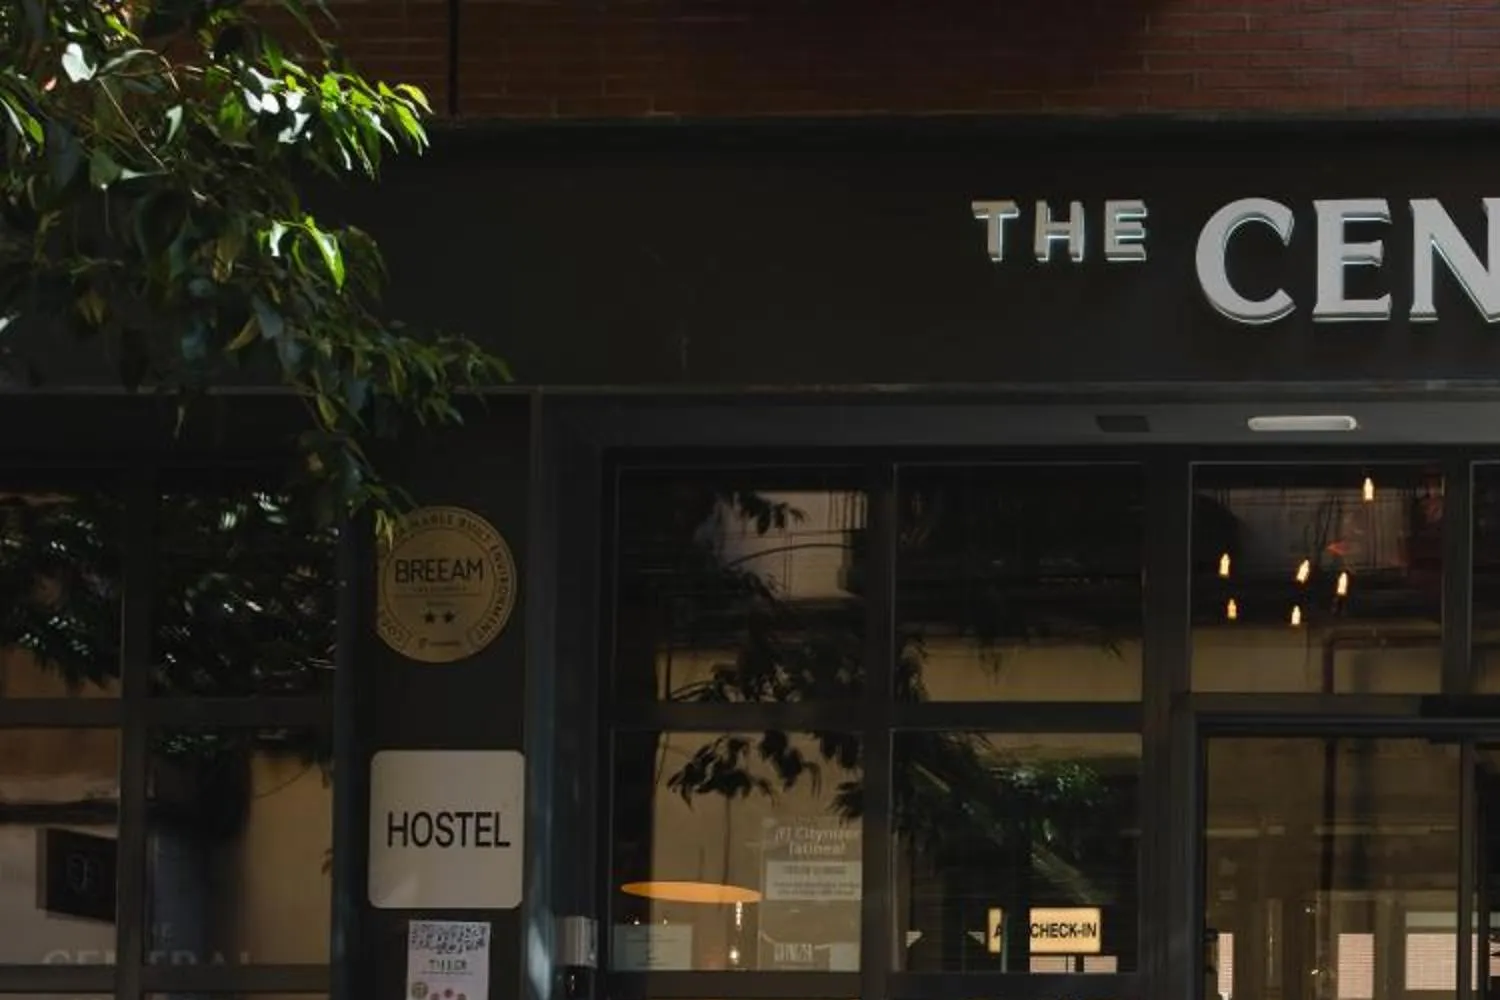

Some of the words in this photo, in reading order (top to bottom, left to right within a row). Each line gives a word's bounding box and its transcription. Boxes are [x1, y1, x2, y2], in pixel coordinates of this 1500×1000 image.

[974, 200, 1148, 262] THE
[394, 557, 484, 584] BREEAM
[387, 811, 511, 848] HOSTEL
[1030, 922, 1097, 939] CHECK-IN
